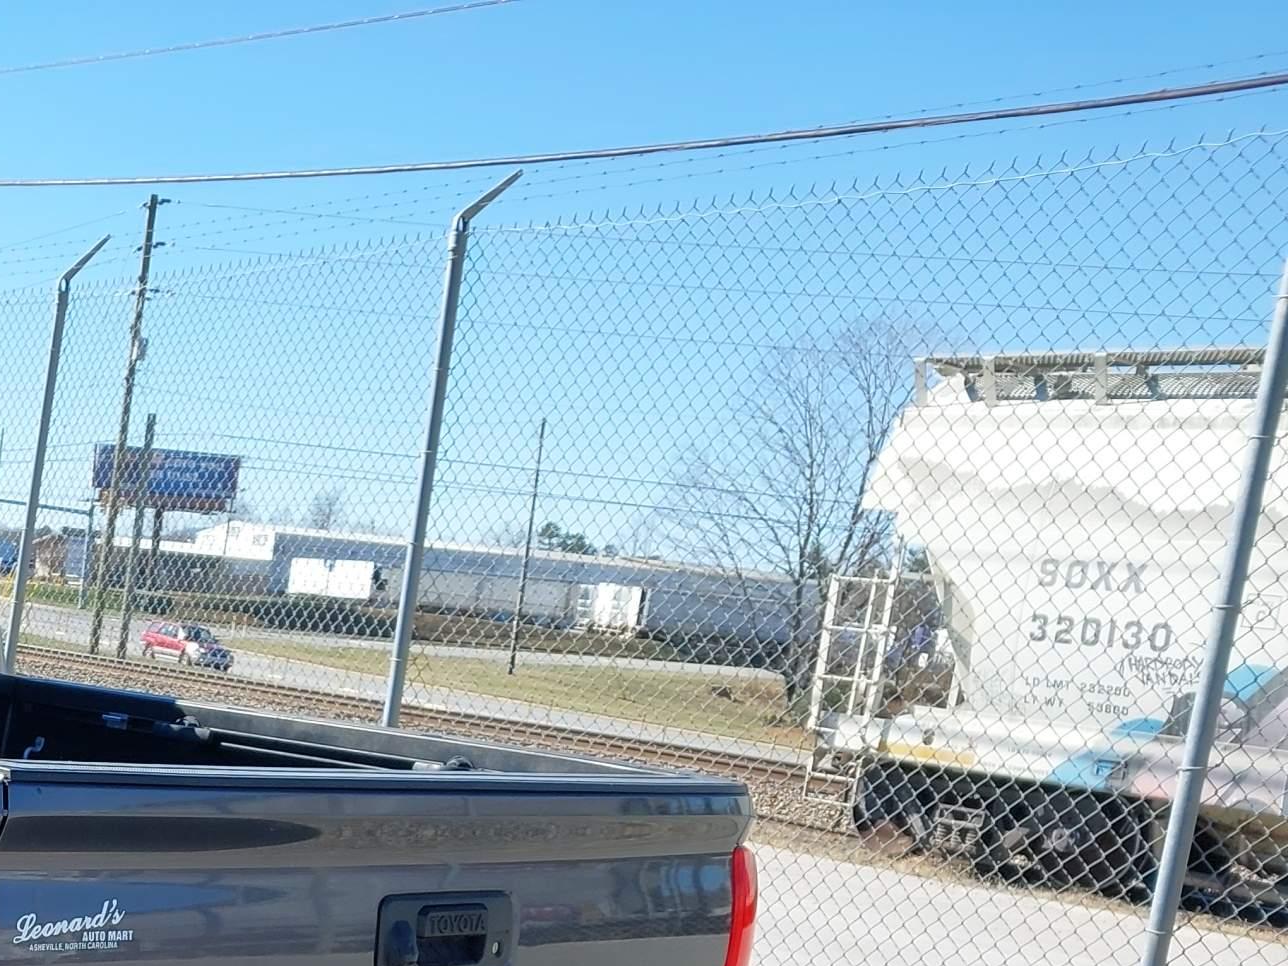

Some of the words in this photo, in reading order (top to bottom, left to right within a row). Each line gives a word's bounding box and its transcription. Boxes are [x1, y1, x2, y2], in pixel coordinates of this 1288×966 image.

[1028, 613, 1173, 652] 320130
[13, 898, 126, 944] Leonard's
[430, 912, 486, 934] TOYOTA
[65, 942, 86, 950] NORTH
[87, 942, 118, 950] CAROLINA
[82, 931, 106, 942] AUTO
[108, 930, 133, 941] MART
